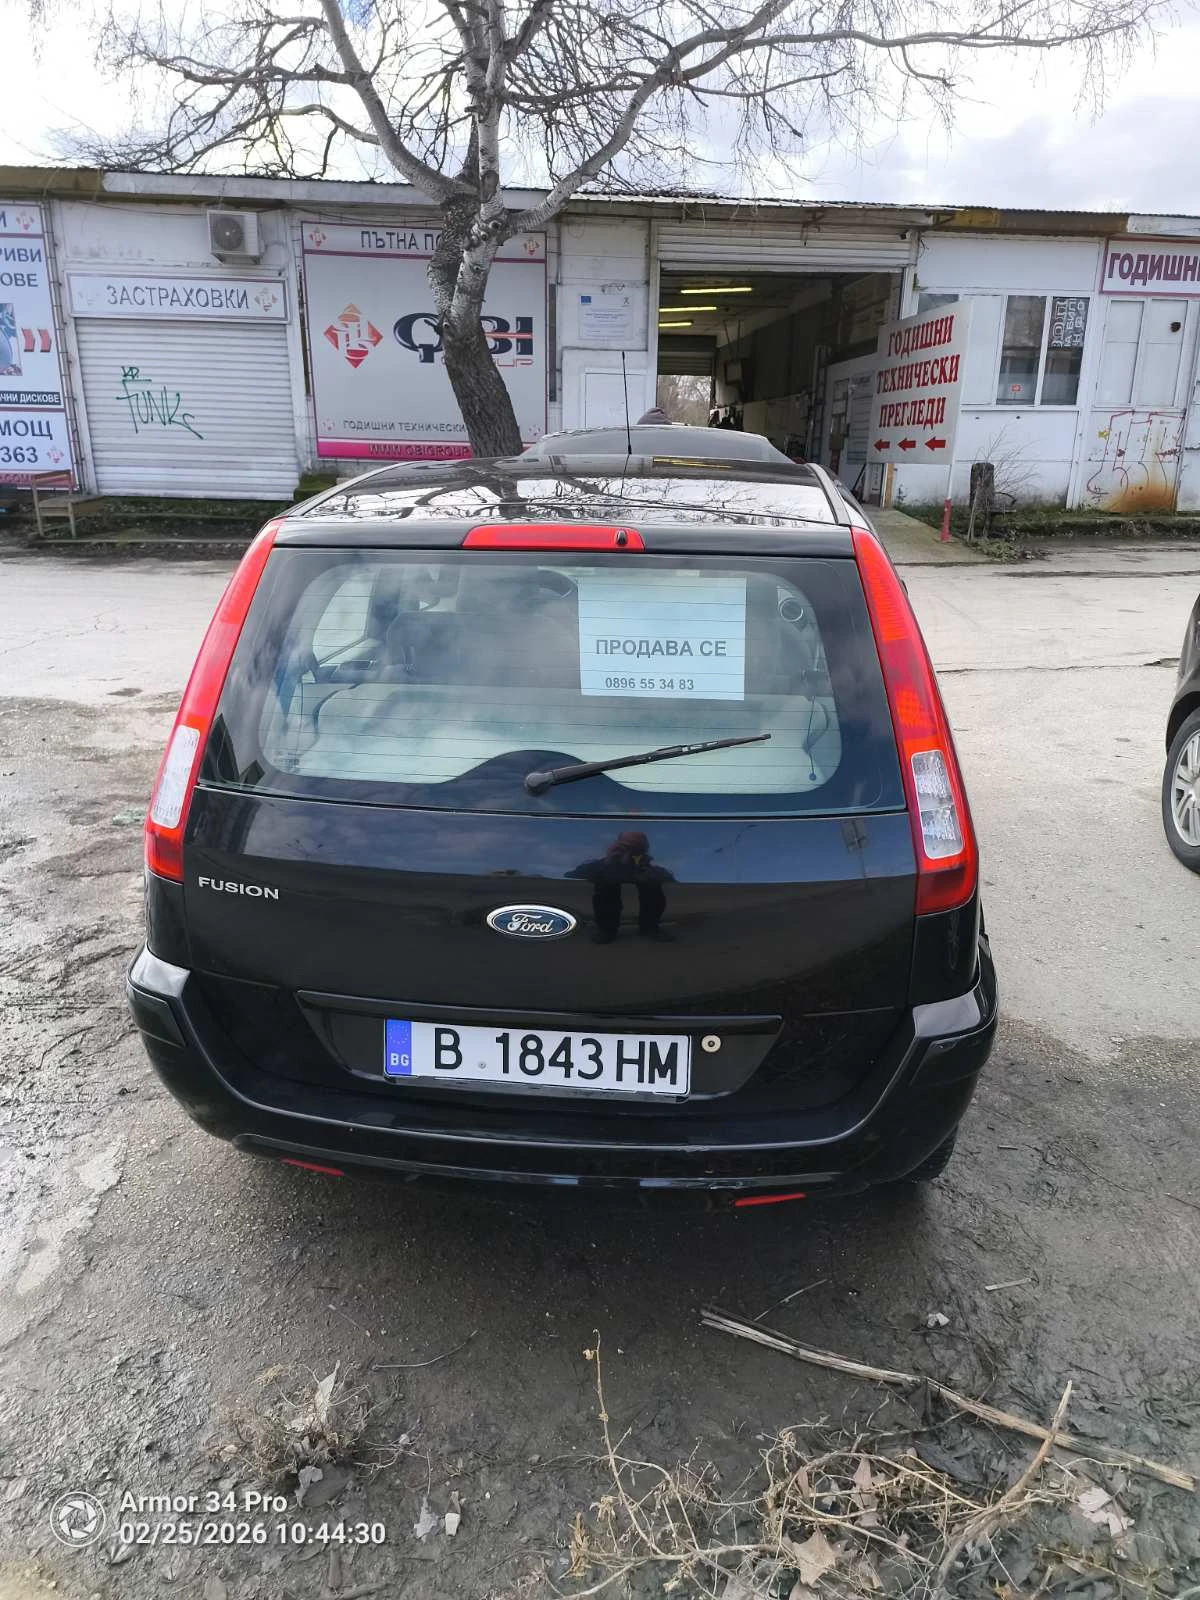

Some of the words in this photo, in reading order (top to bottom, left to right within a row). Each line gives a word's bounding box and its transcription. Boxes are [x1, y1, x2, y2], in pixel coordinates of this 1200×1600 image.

[361, 230, 419, 250] ПЪТНА
[1108, 252, 1200, 286] ГОДИШН
[106, 284, 249, 309] ЗАСТРАХОВКИ
[888, 315, 954, 359] ГОДИШНИ
[877, 354, 960, 394] ТЕХНИЧЕСКИ
[20, 393, 60, 403] ДИСКОВЕ
[343, 420, 395, 431] ГОДИШНИ
[879, 397, 946, 430] ПРЕГЛЕДИ
[596, 639, 693, 658] ПРОДАВА
[700, 641, 727, 656] СЕ
[605, 677, 636, 689] 0896
[640, 678, 655, 689] 55
[659, 679, 674, 690] 34
[679, 679, 694, 690] 83
[198, 876, 279, 900] FUSION
[507, 913, 554, 932] Ford
[390, 1053, 409, 1067] BG
[496, 1032, 604, 1080] 1843
[616, 1040, 679, 1085] HM
